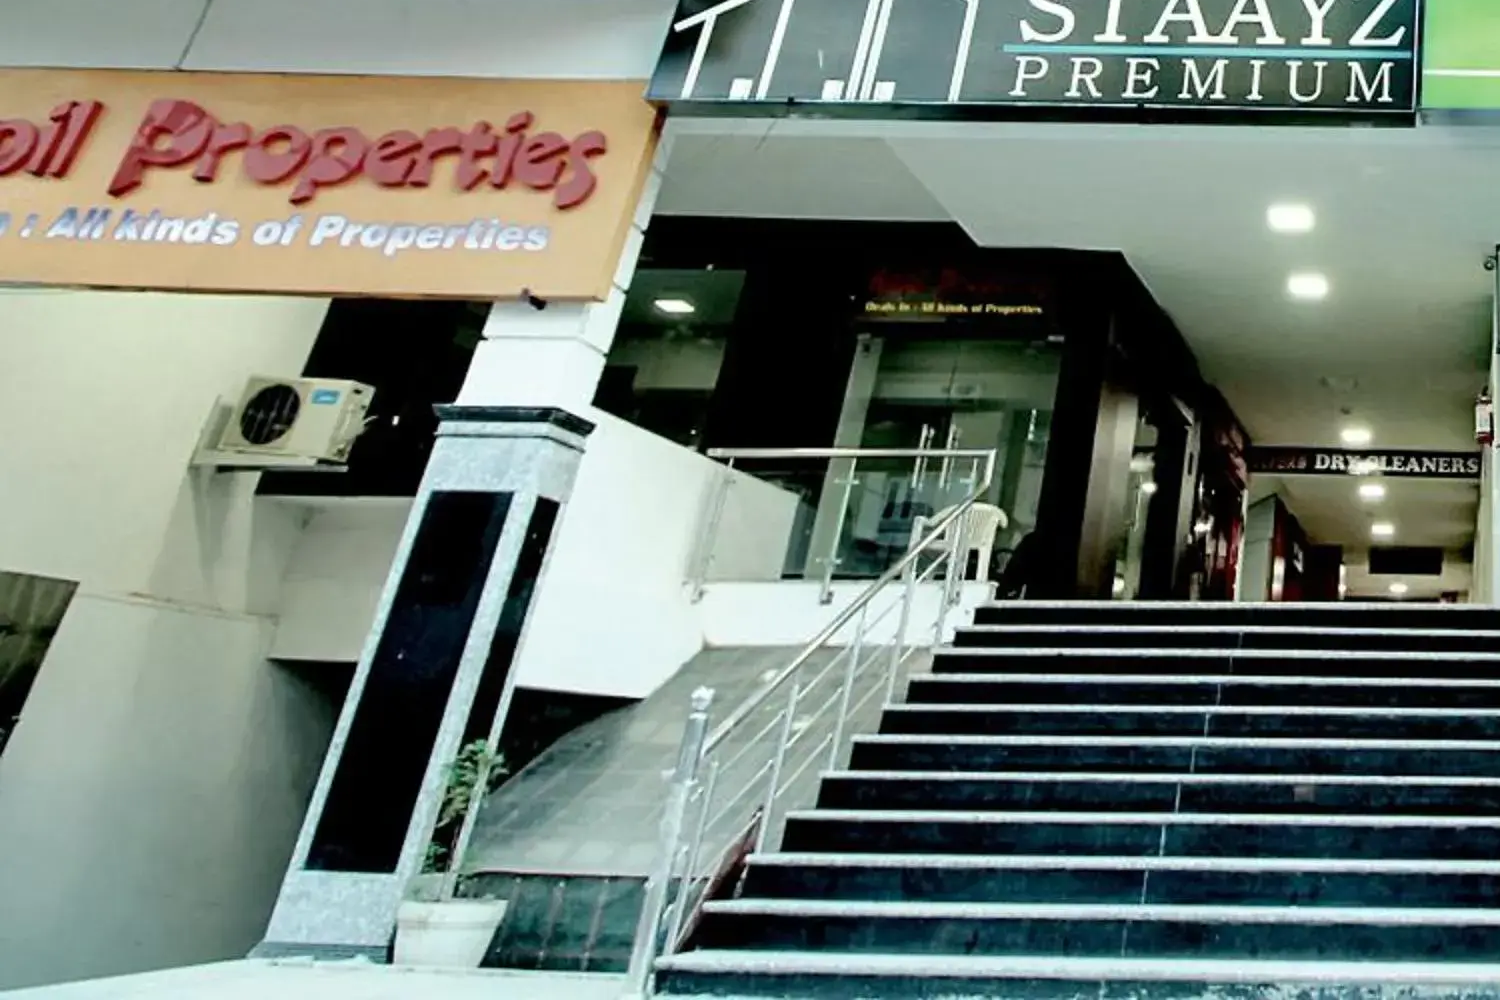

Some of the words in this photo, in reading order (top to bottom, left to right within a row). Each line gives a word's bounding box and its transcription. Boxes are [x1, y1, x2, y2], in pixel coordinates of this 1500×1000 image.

[1007, 55, 1396, 103] PREMIUM
[107, 98, 608, 210] Properties
[46, 207, 113, 240] All
[114, 207, 240, 246] kinds
[252, 214, 304, 246] of
[309, 214, 550, 256] Properties
